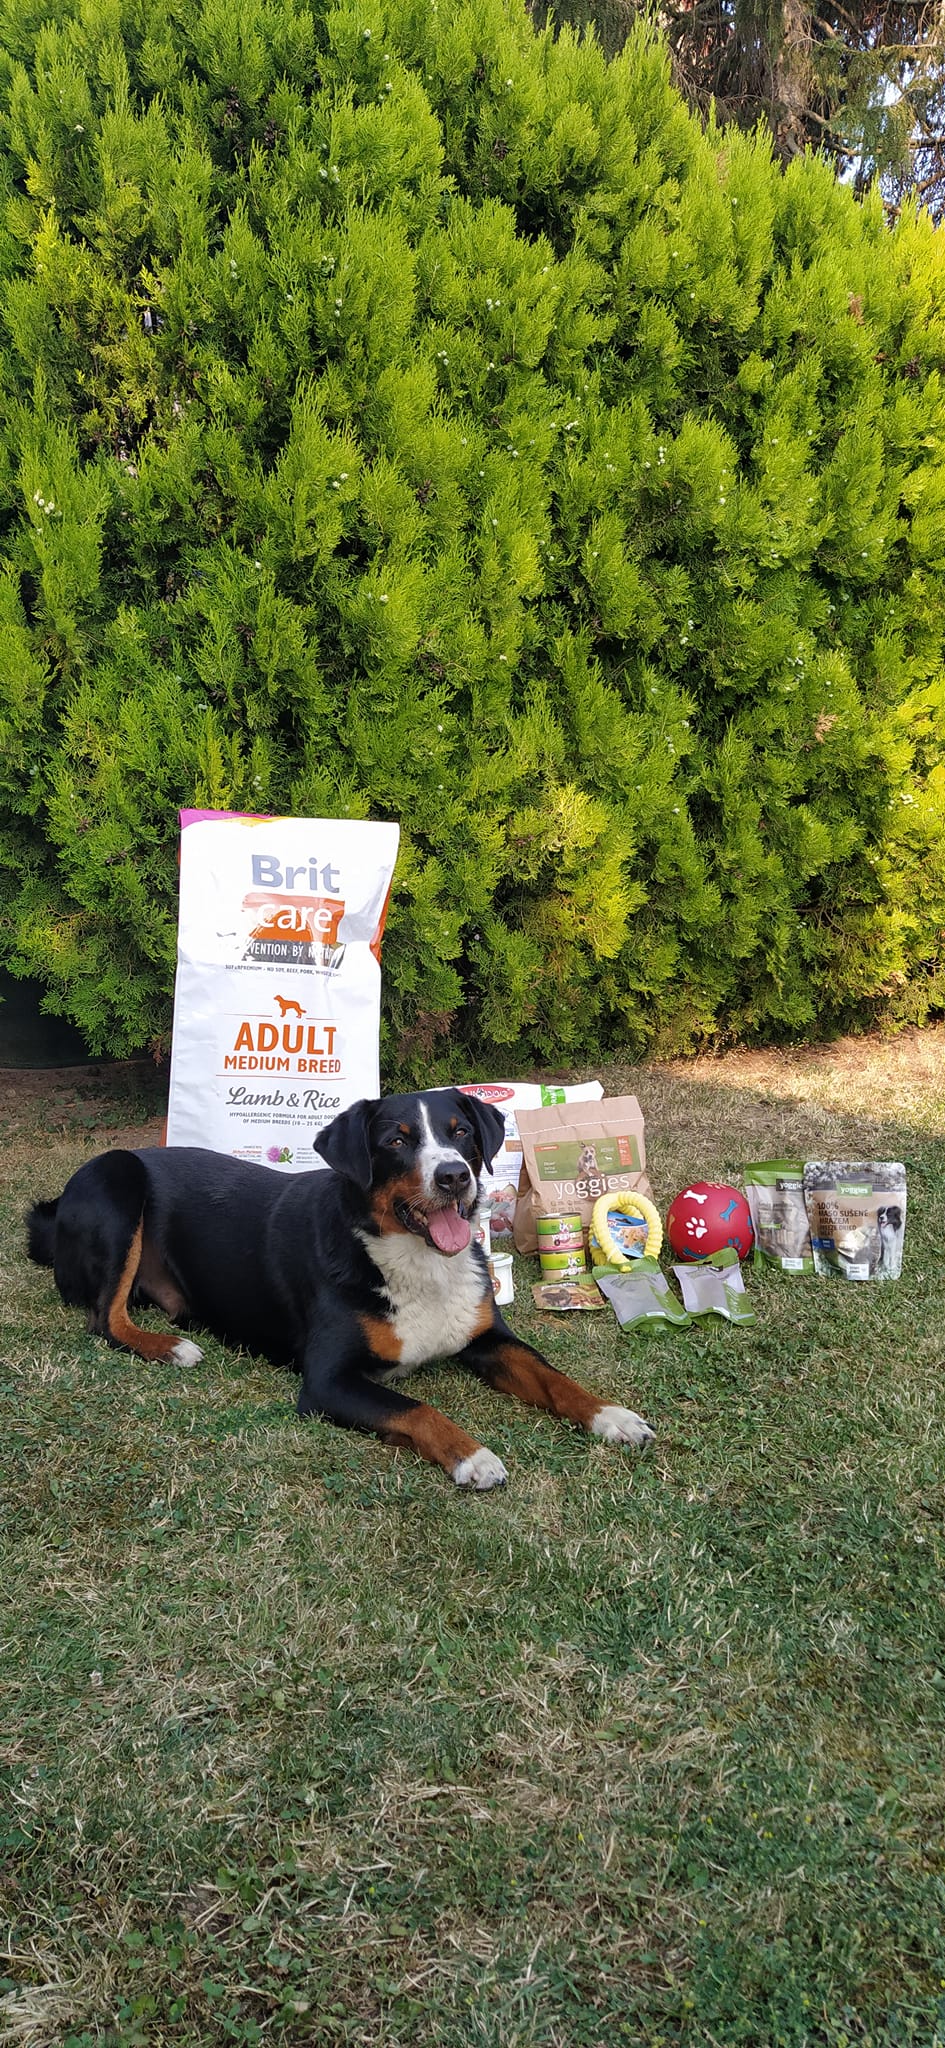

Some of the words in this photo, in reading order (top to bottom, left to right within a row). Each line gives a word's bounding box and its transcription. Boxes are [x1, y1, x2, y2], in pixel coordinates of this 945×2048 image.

[251, 854, 340, 893] Brit
[258, 903, 333, 933] care
[292, 944, 304, 957] BY
[233, 1022, 337, 1055] ADULT
[223, 1055, 290, 1072] MEDIUM
[297, 1058, 341, 1073] BREED
[225, 1086, 284, 1106] Lamb
[286, 1092, 300, 1108] &
[302, 1089, 341, 1111] Rice
[553, 1173, 630, 1200] yoggies
[779, 1181, 803, 1190] yoggie
[840, 1186, 869, 1194] yoggies
